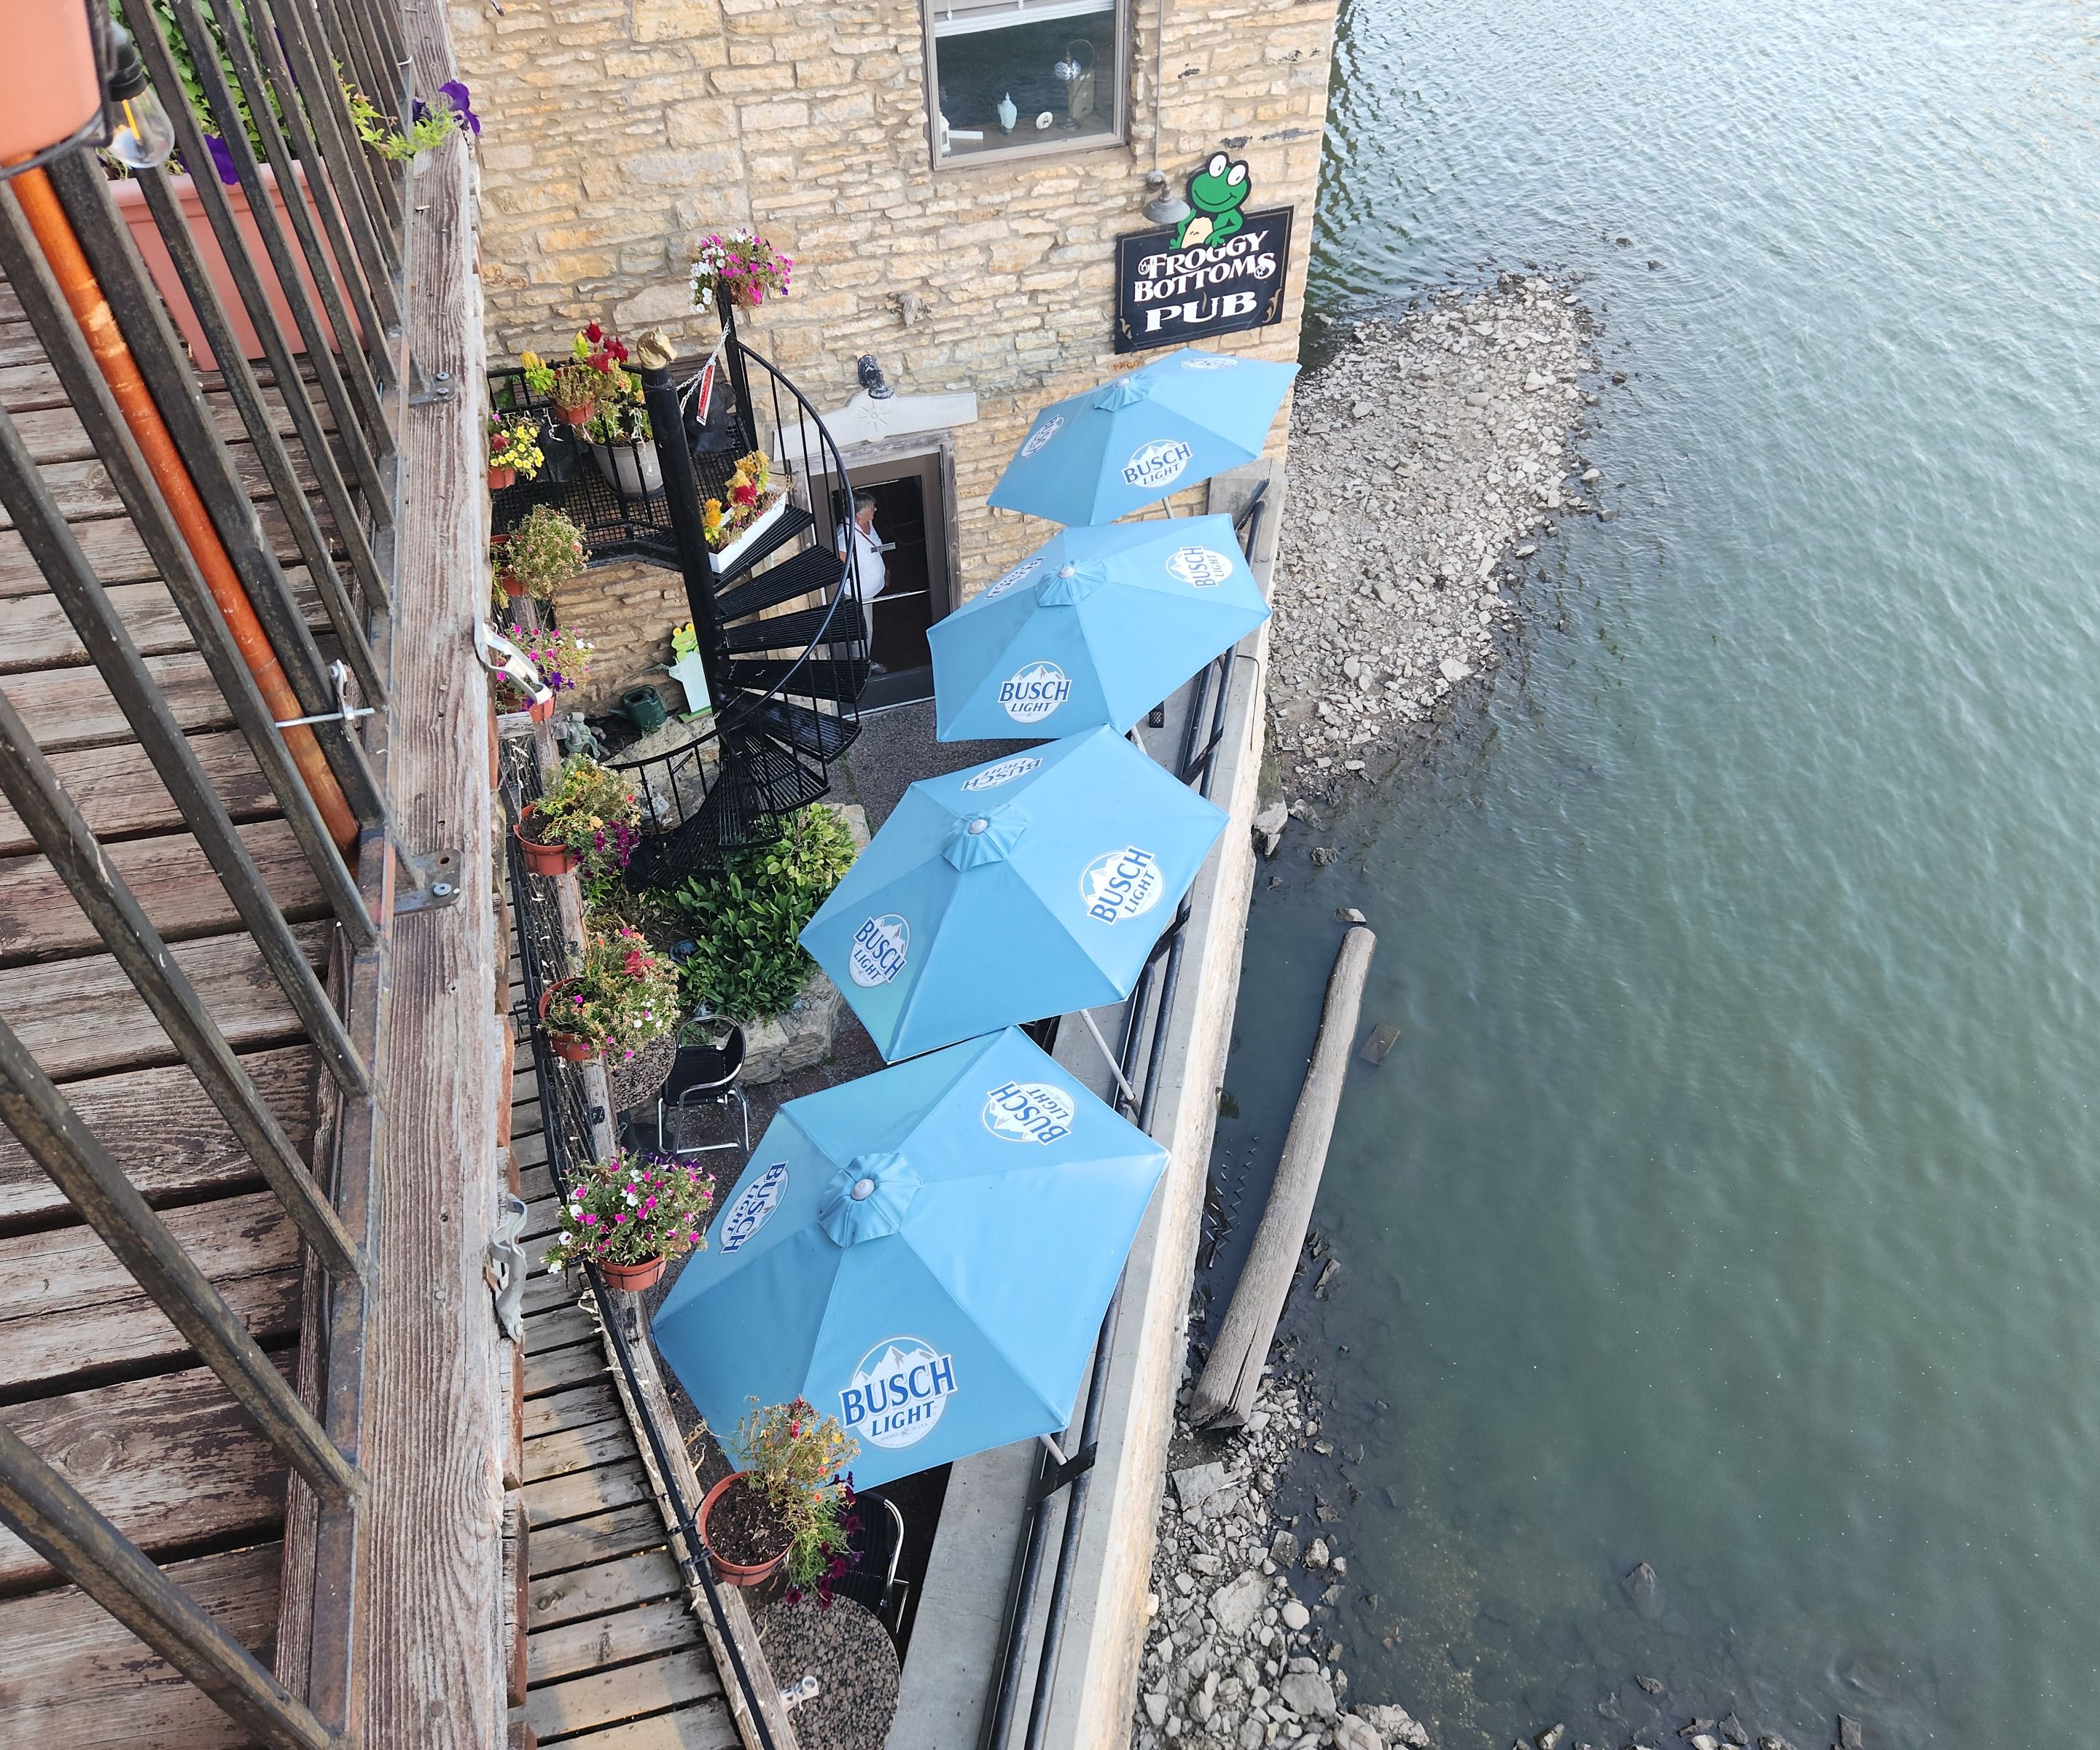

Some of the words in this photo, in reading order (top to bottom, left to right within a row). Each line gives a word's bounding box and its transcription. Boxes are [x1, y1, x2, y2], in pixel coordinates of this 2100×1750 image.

[1138, 230, 1268, 279] FROGGY
[1133, 253, 1276, 302] BOTTOMS
[1145, 292, 1257, 332] PUB
[1123, 443, 1190, 483] BUSCH
[1144, 463, 1179, 485] LIGHT
[1182, 547, 1217, 586] BUSCH
[1206, 555, 1225, 577] LIGHT
[999, 681, 1070, 701] BUSCH
[1011, 703, 1052, 712] LIGHT
[964, 759, 1041, 789] BUSCH
[1090, 848, 1152, 923] BUSCH
[1125, 870, 1155, 913] LIGHT
[854, 949, 881, 980] LIGHT
[855, 919, 905, 981] BUSCH
[990, 1083, 1069, 1144] BUSCH
[1026, 1089, 1069, 1120] LIGHT
[722, 1163, 786, 1251] BUSCH
[727, 1184, 759, 1235] LIGHT
[841, 1357, 955, 1426] BUSCH
[872, 1400, 934, 1437] LIGHT
